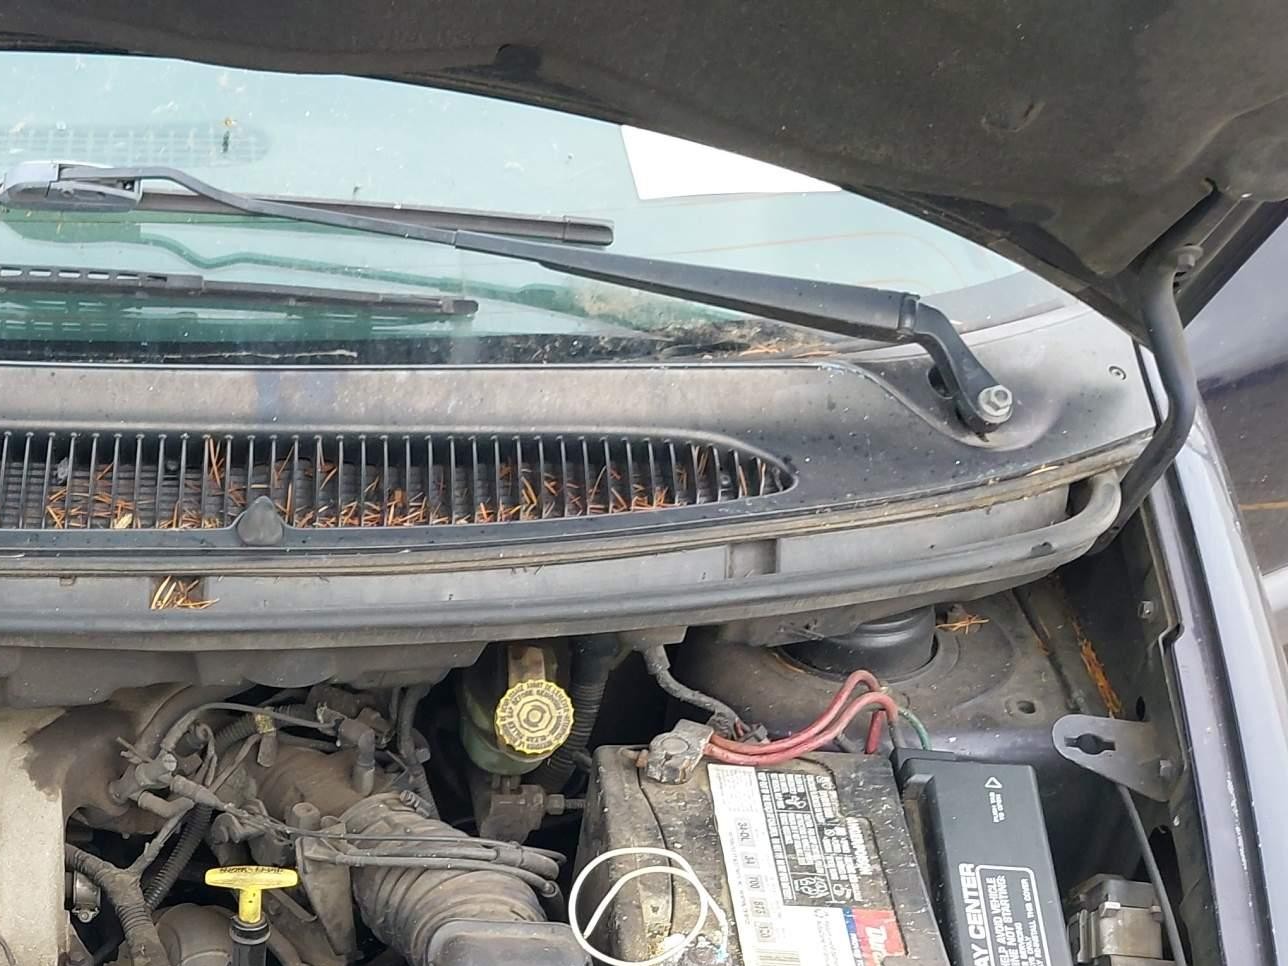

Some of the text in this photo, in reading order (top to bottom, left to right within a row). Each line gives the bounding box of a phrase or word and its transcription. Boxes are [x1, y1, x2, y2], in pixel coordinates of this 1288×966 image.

[958, 863, 986, 940] CENTER
[985, 877, 1002, 915] VEHICLE
[992, 916, 1007, 945] AVOID
[1004, 924, 1017, 947] NOT
